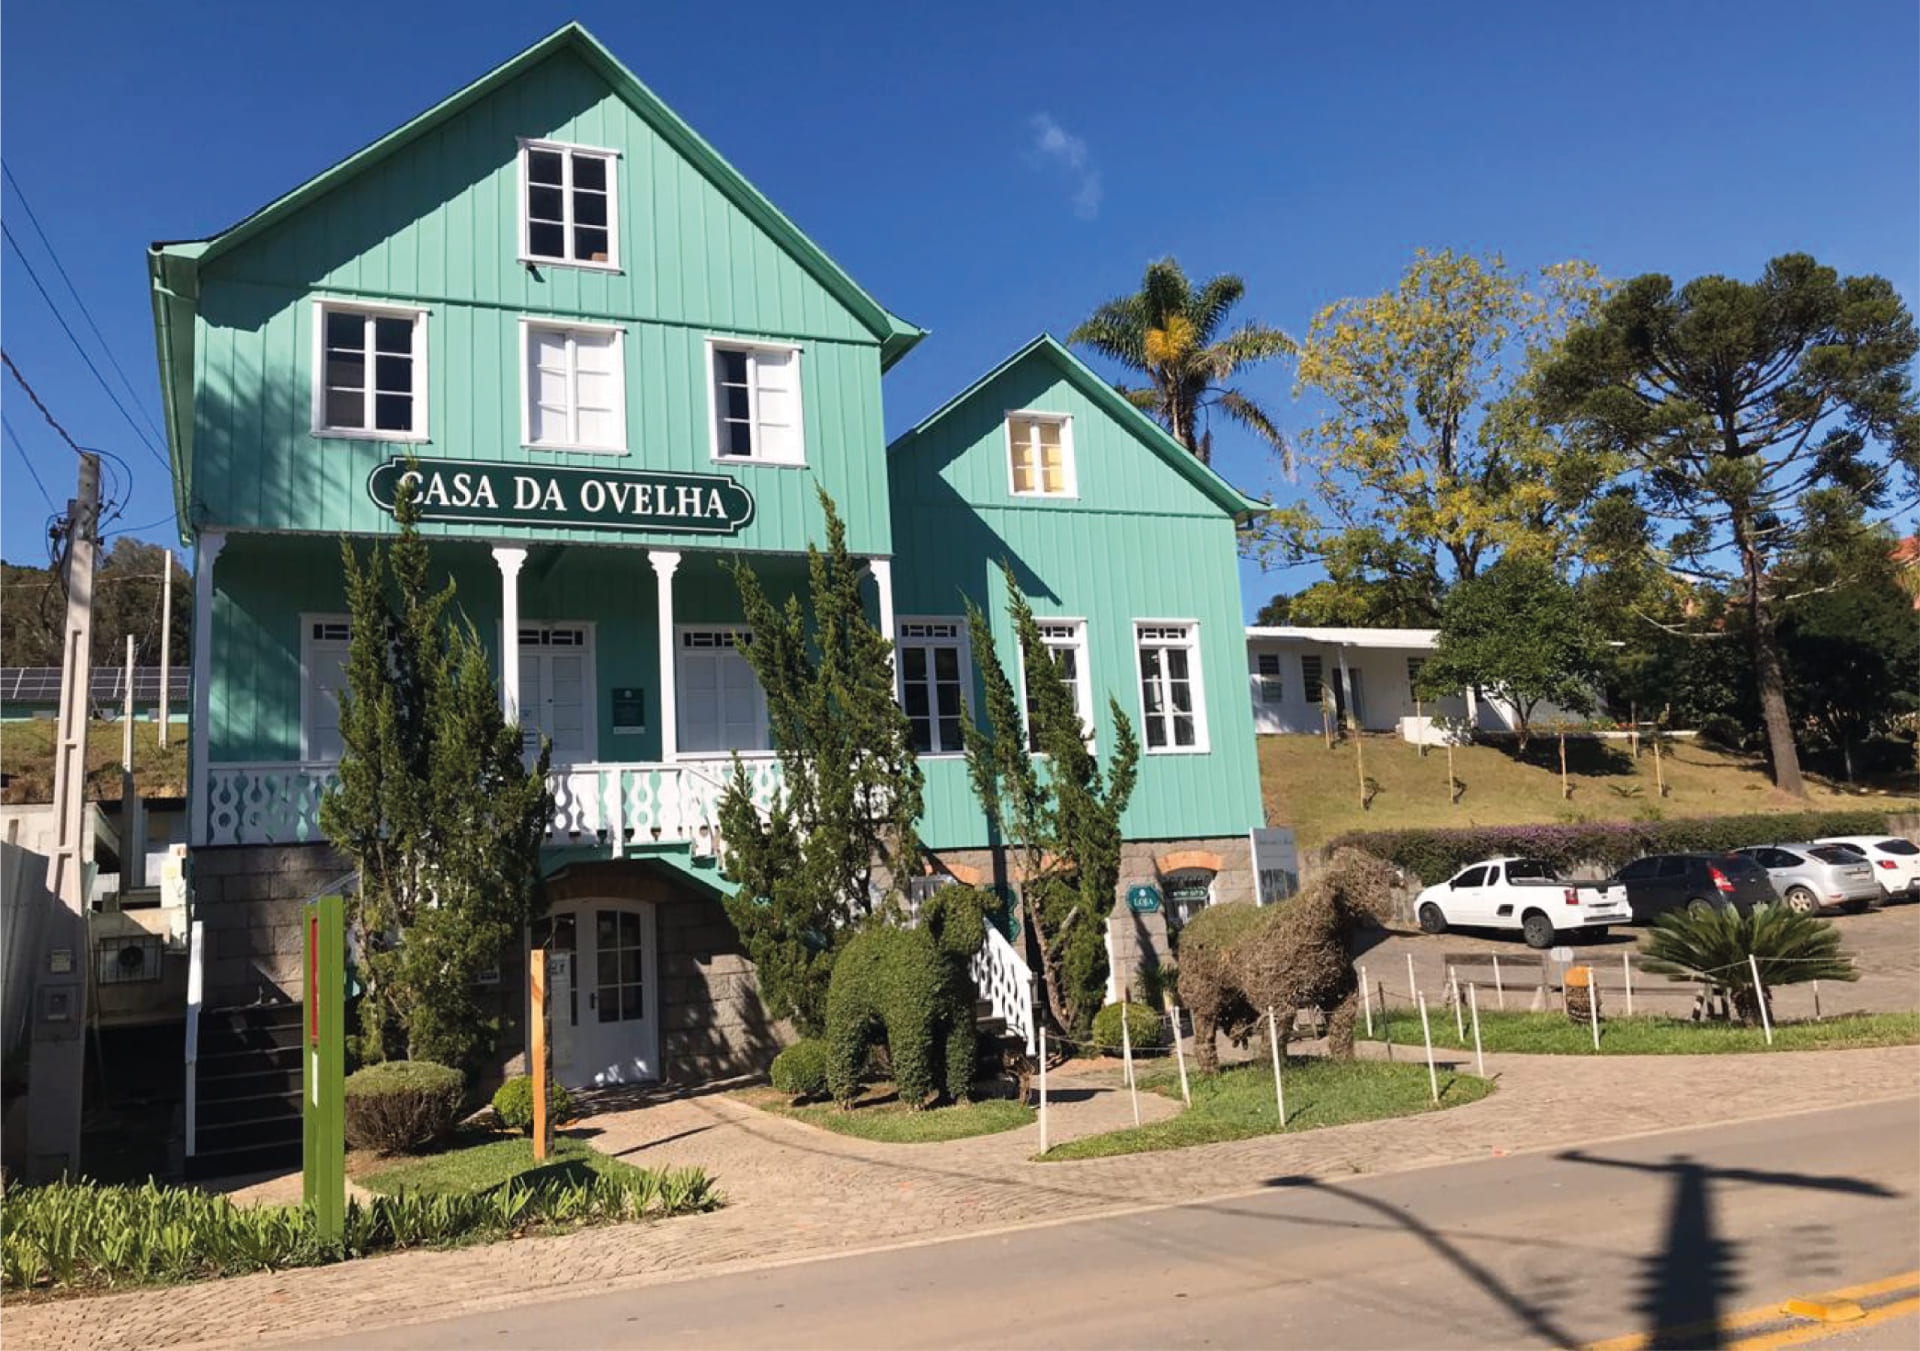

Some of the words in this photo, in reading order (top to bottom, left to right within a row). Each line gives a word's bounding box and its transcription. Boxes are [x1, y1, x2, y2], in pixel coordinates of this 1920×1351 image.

[399, 471, 499, 508] CASA
[514, 476, 567, 511] DA
[580, 479, 729, 519] OVELHA
[1133, 897, 1154, 907] LOJA
